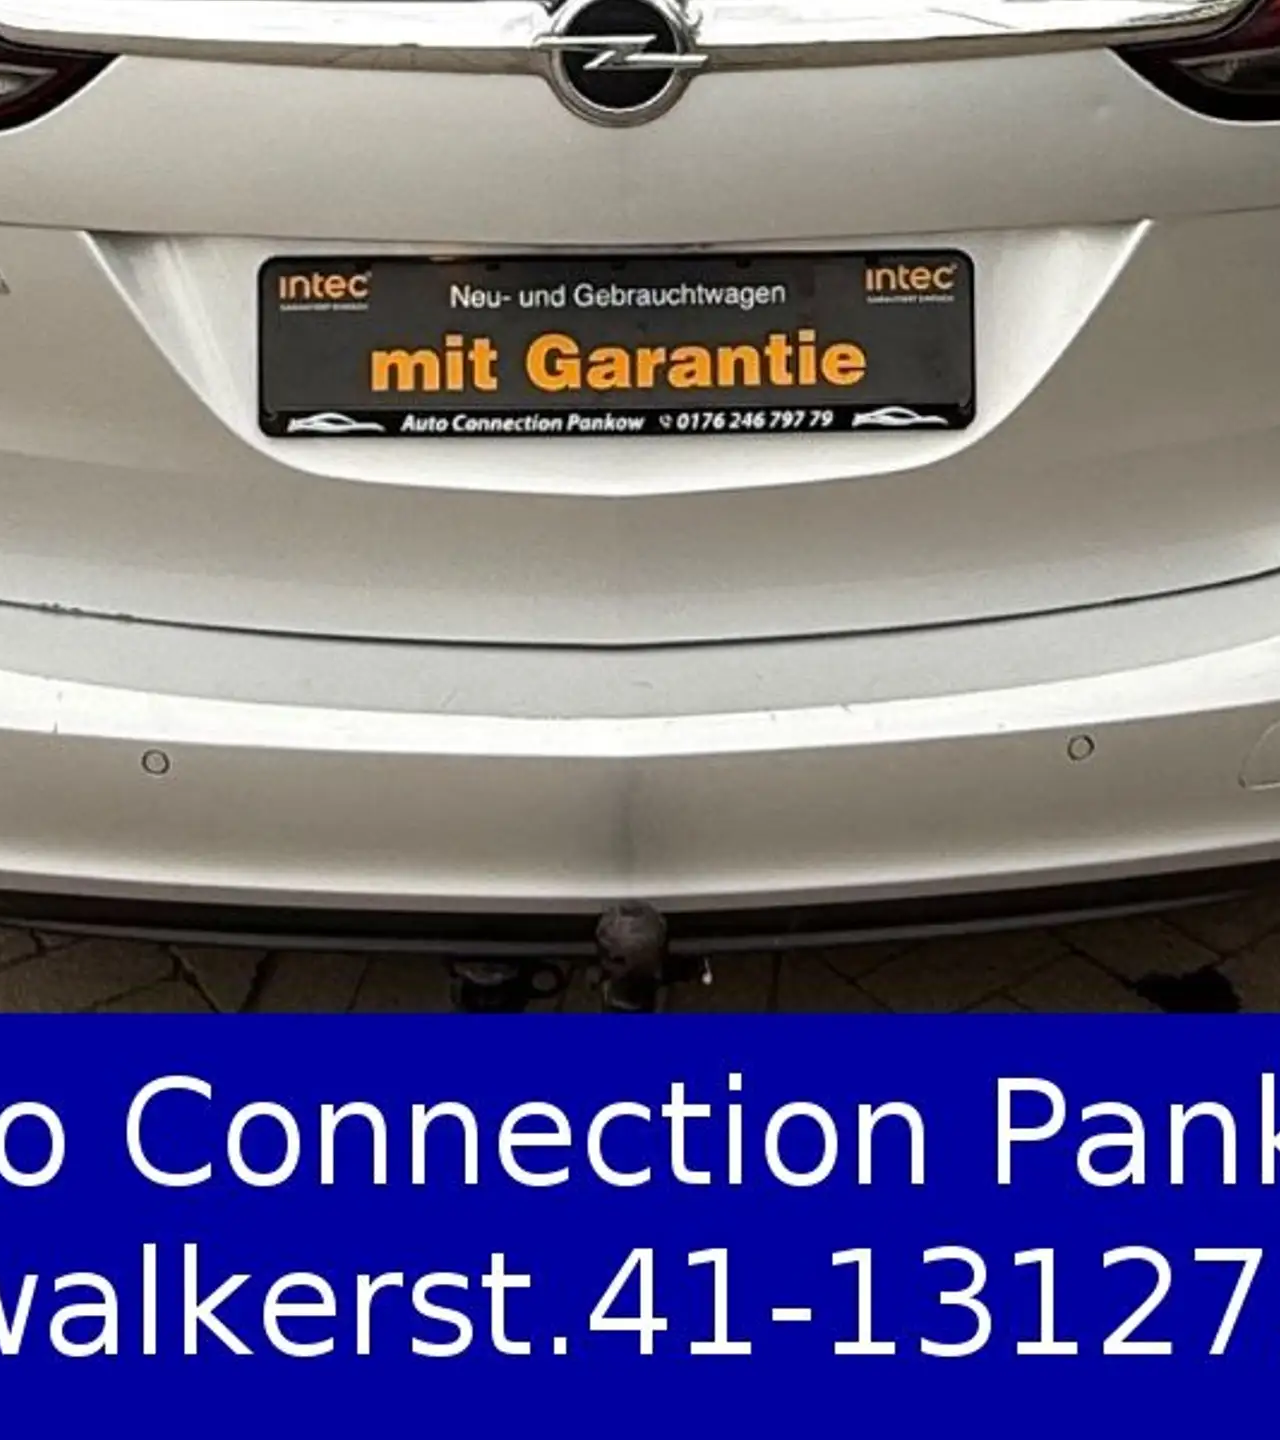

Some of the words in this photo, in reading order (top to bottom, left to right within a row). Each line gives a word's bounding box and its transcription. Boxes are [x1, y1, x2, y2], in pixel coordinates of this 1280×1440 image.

[278, 270, 370, 300] intec
[865, 263, 956, 292] intec
[450, 284, 511, 309] Neu-
[519, 284, 565, 307] und
[573, 282, 786, 310] Gebrauchtwagen
[371, 334, 498, 392] mit
[525, 329, 867, 392] Garantie
[400, 414, 448, 433] Auto
[451, 412, 564, 432] Connection
[567, 413, 646, 432] Pankow
[676, 411, 726, 431] 0176
[729, 410, 767, 430] 246
[770, 410, 805, 429] 797
[808, 409, 835, 428] 79
